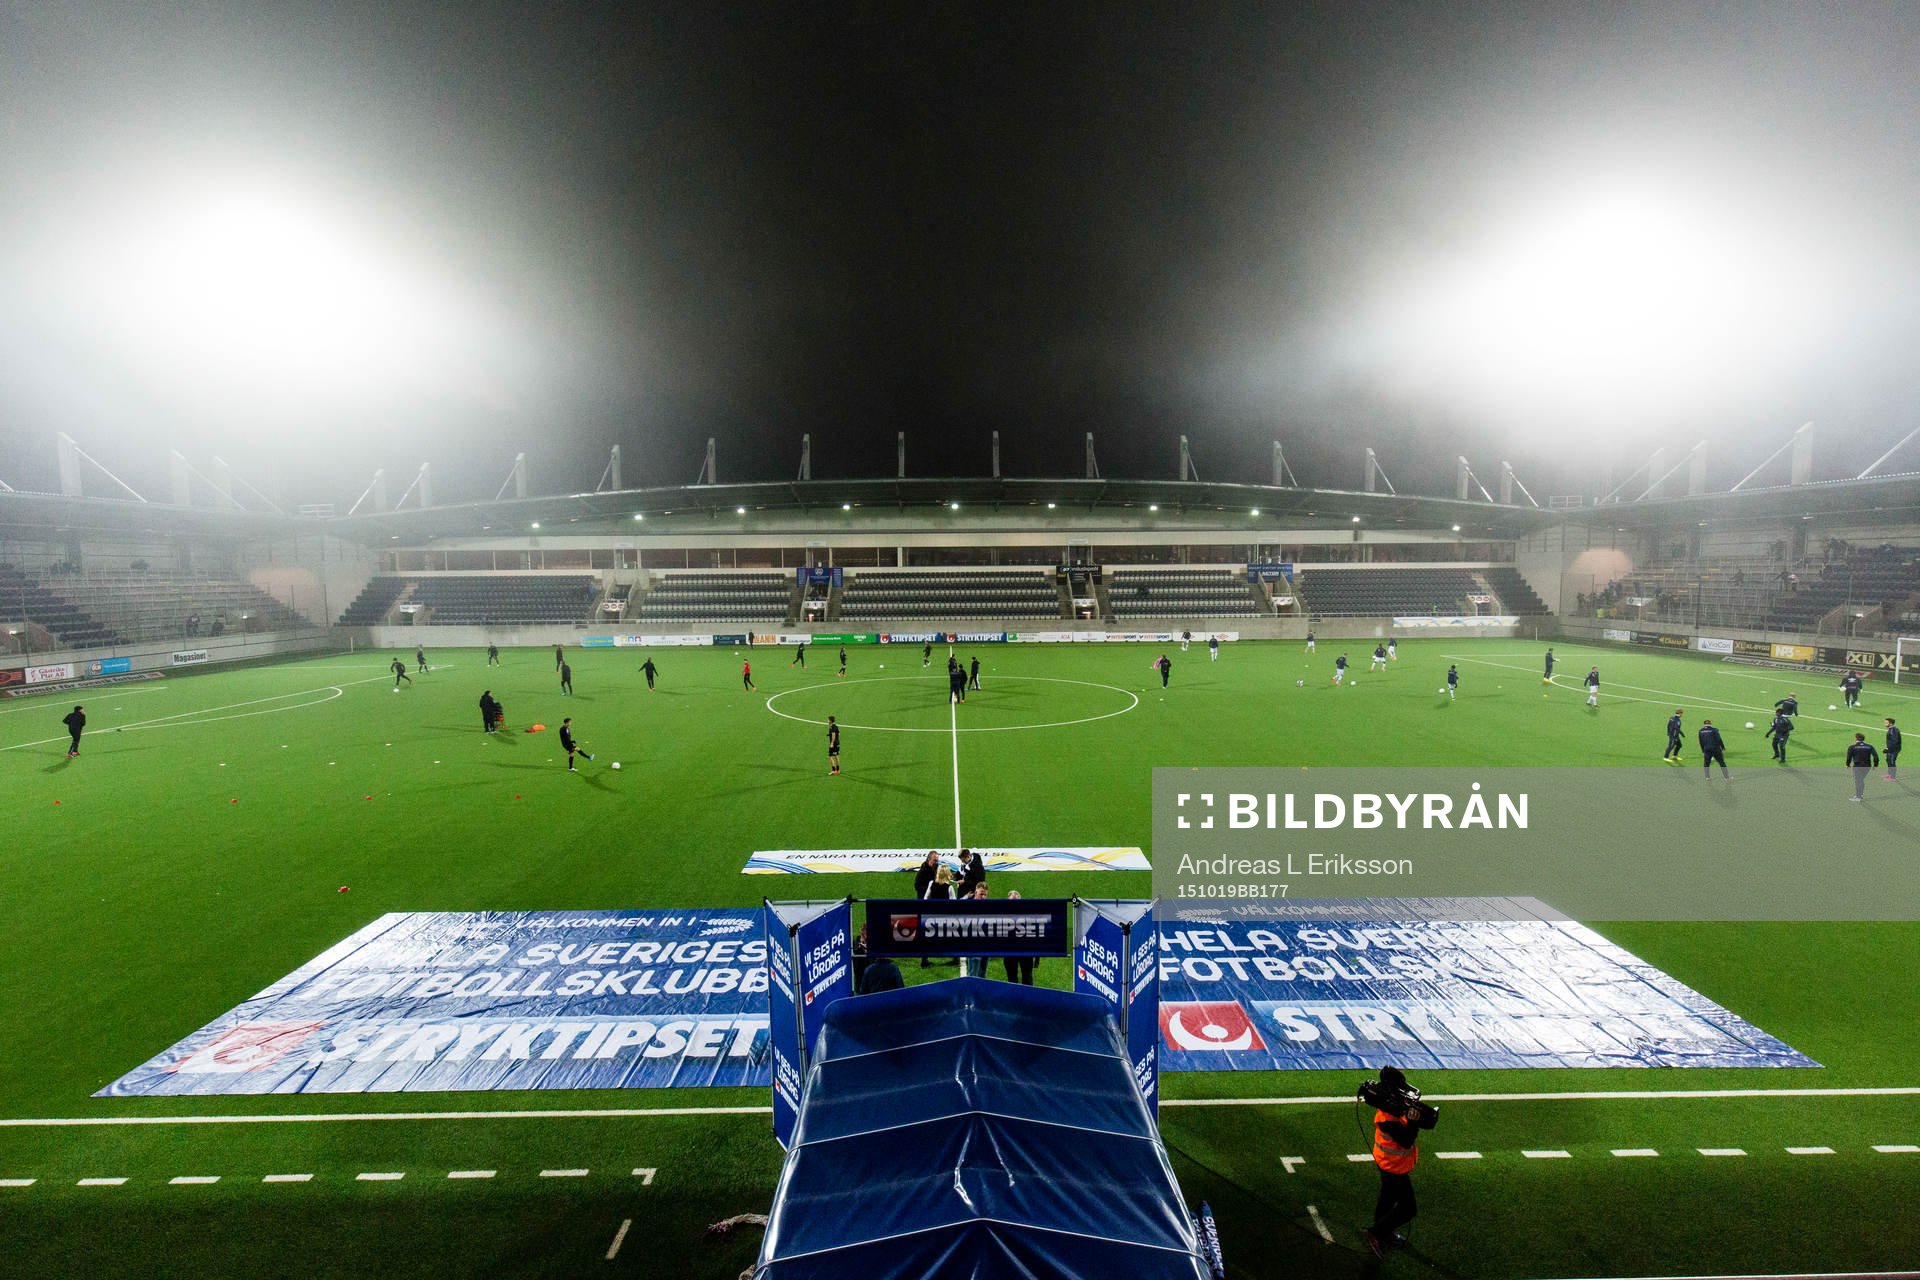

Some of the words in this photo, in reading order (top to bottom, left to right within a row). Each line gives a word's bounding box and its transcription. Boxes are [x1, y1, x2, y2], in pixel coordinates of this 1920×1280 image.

[891, 633, 937, 642] STRYKTIPSET
[957, 633, 1003, 642] STRYKTIPSET
[174, 652, 206, 663] Magasinet
[659, 917, 682, 927] IN
[688, 917, 697, 927] I
[925, 915, 1049, 938] STRYKTIPSET
[519, 940, 766, 965] SVERIGES
[804, 951, 812, 968] VI
[813, 940, 830, 961] SES
[831, 928, 845, 949] PÅ
[1160, 930, 1288, 951] HELA
[1089, 938, 1105, 960] SES
[1106, 950, 1118, 970] PÅ
[808, 950, 841, 984] LÖRDAG
[1082, 950, 1114, 984] LÖRDAG
[305, 1021, 769, 1069] STRYKTIPSET
